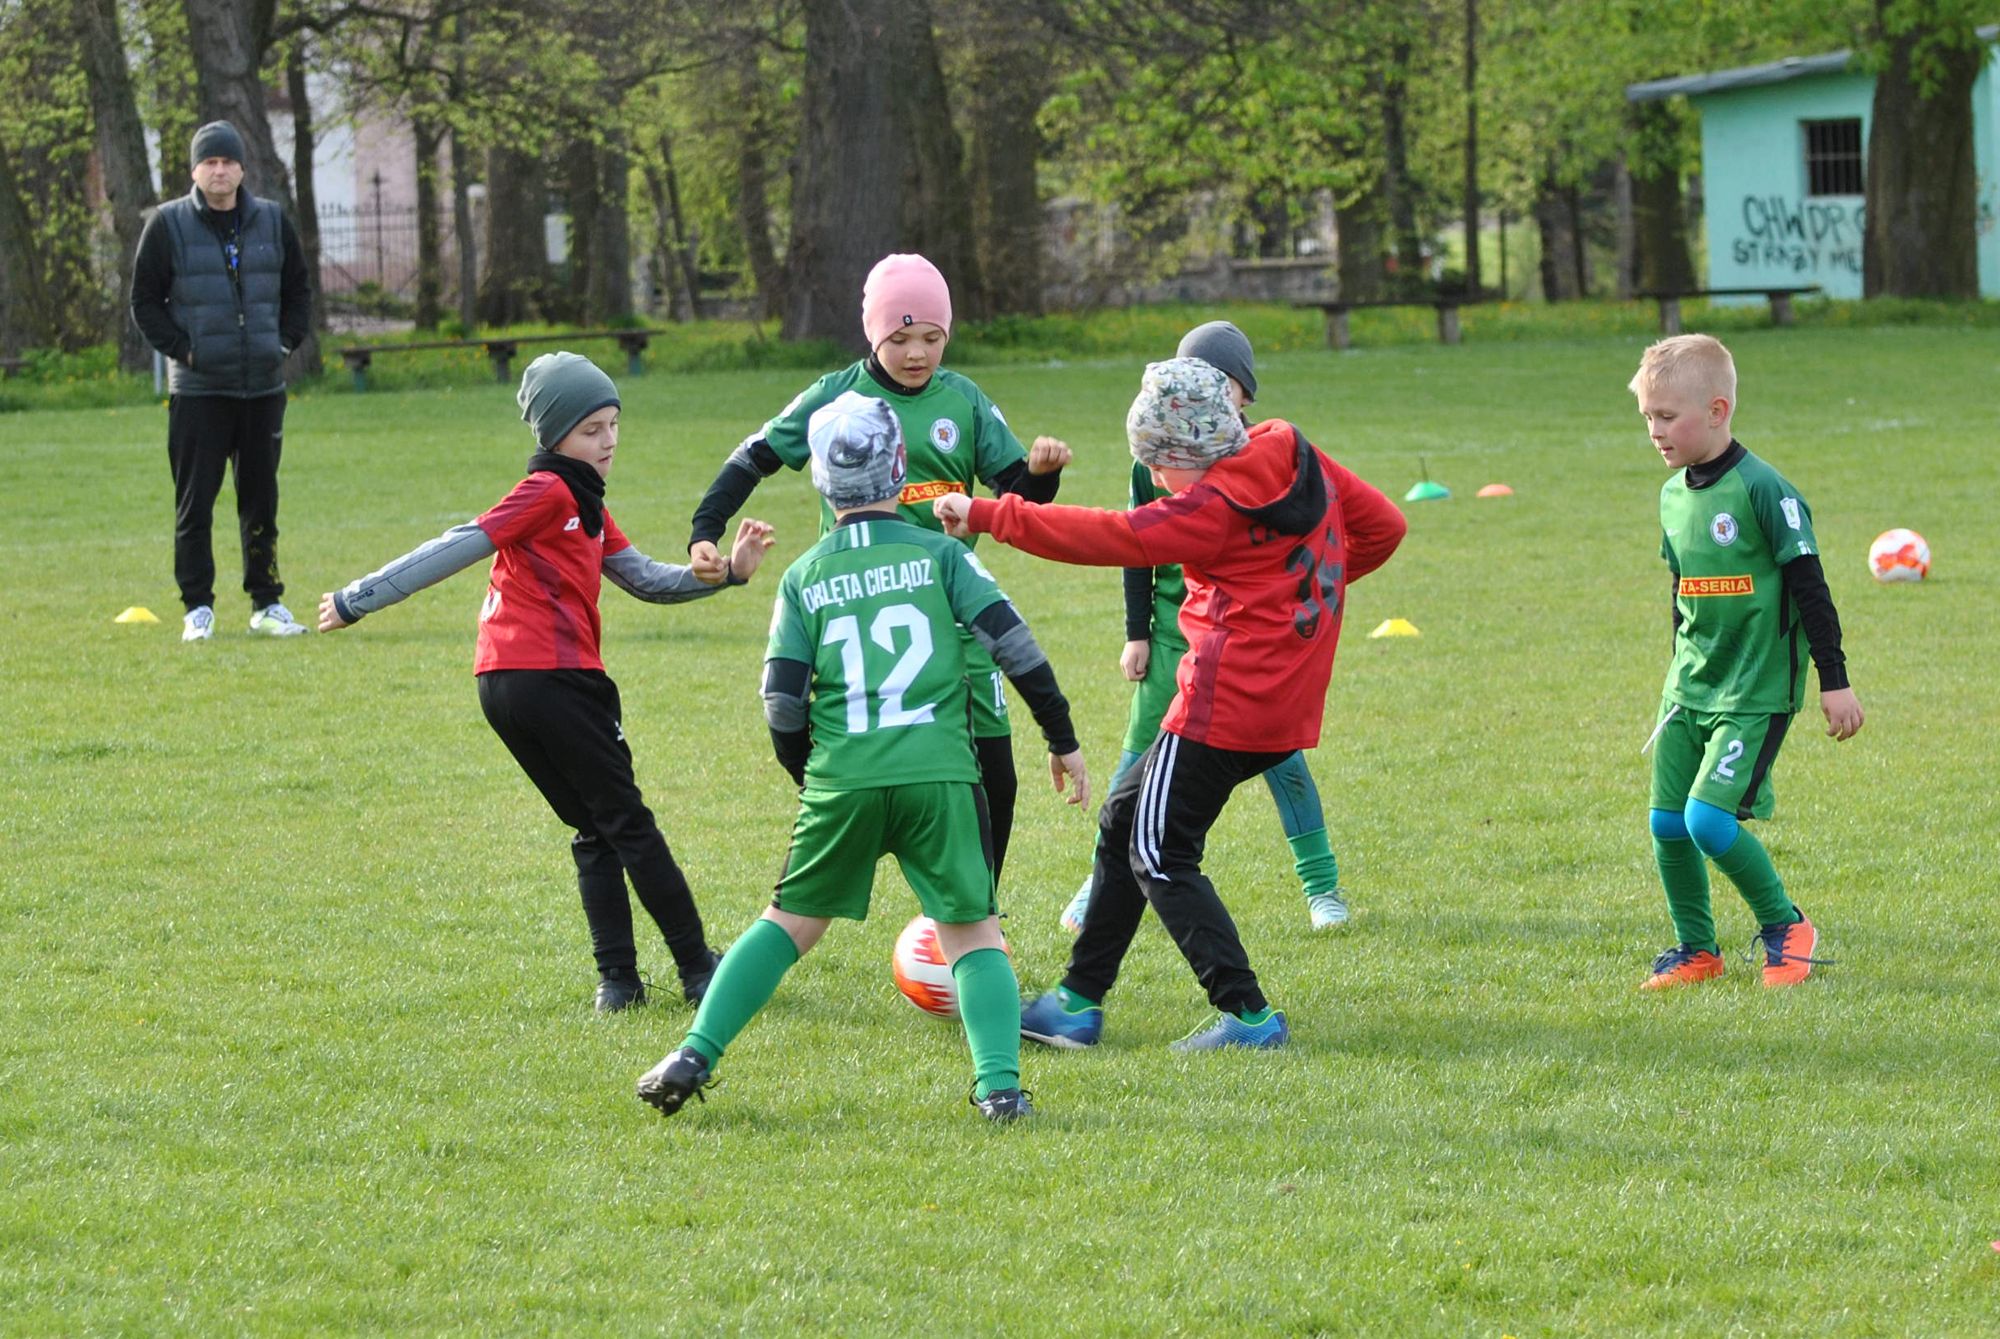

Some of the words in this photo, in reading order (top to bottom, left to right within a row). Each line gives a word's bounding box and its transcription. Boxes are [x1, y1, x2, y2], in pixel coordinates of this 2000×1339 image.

[802, 573, 864, 614] ORLĘTA
[864, 558, 934, 597] CIELĄDZ
[822, 603, 938, 733] 12
[1716, 739, 1744, 778] 2
